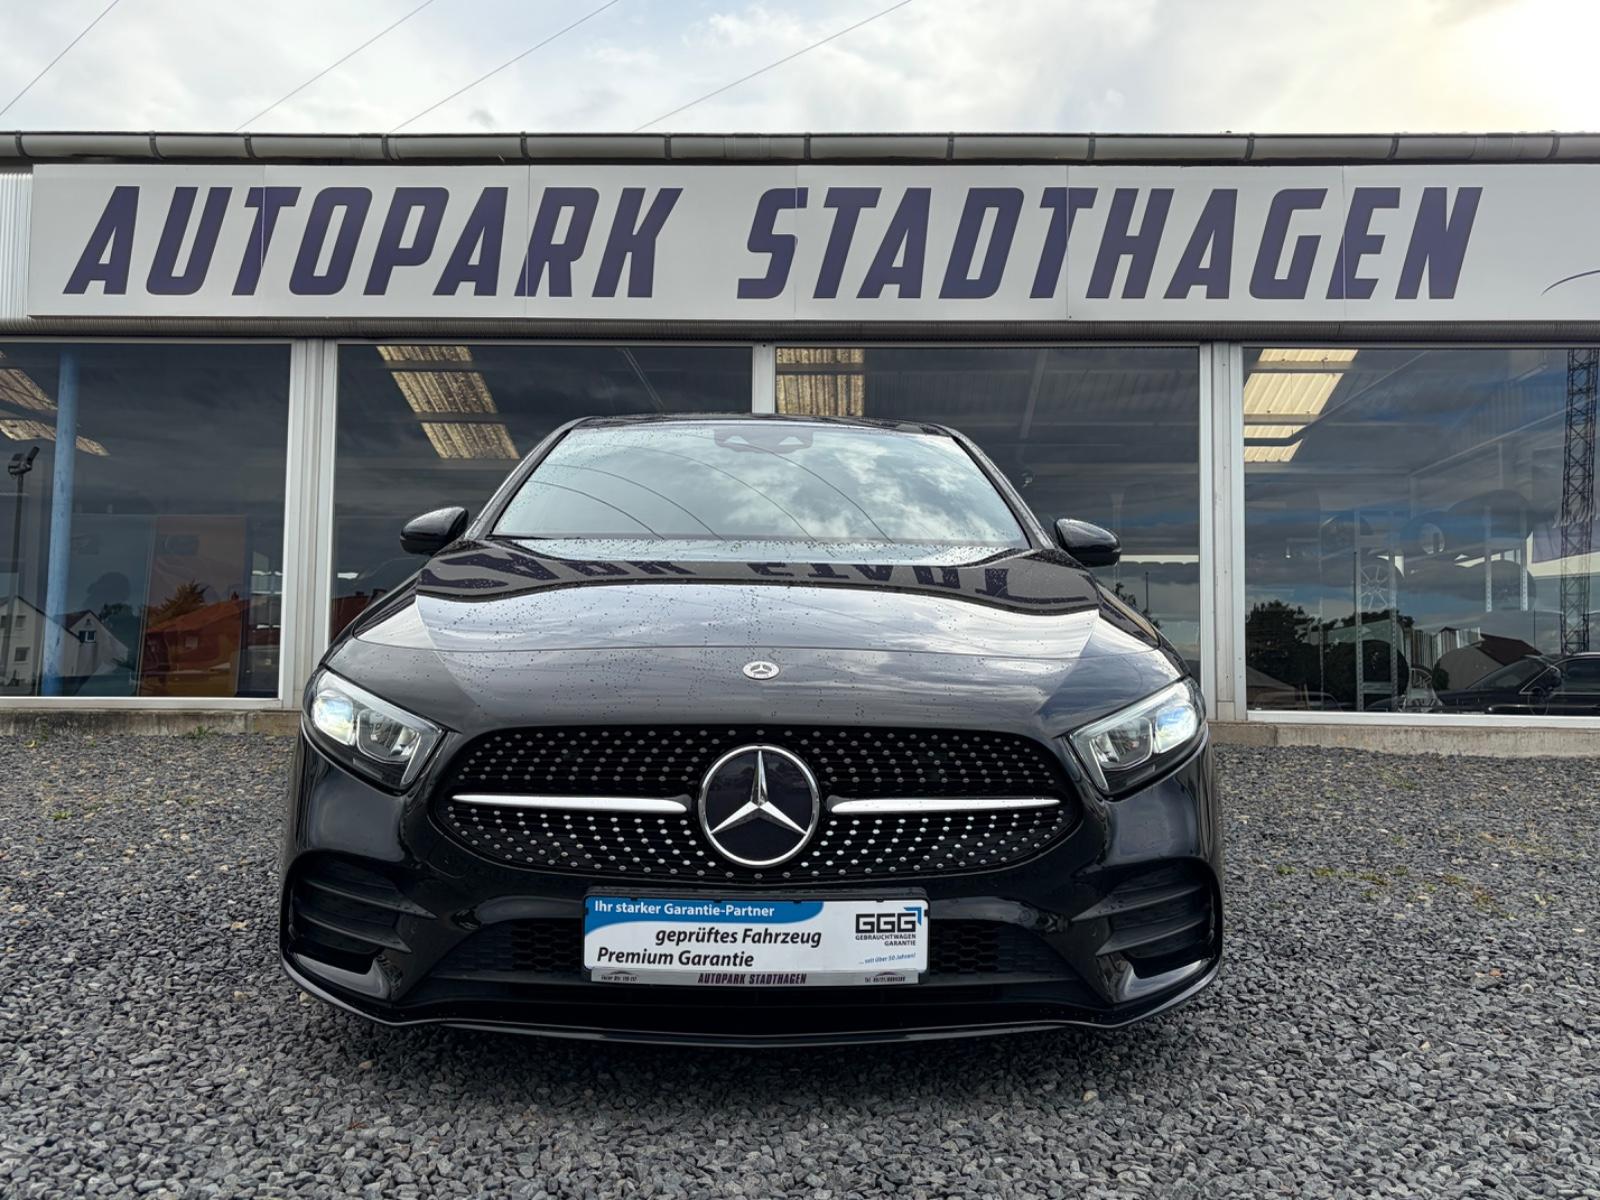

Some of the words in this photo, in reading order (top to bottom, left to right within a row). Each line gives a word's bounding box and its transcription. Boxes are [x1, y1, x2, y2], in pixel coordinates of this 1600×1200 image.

[63, 186, 683, 299] AUTOPARK
[737, 187, 1482, 300] STADTHAGEN
[595, 900, 613, 912] Ihr
[616, 902, 661, 914] starker
[664, 903, 775, 917] Garantie-Partner
[856, 913, 916, 933] GGG
[656, 926, 739, 946] geprüftes
[742, 928, 822, 948] Fahrzeug
[597, 947, 673, 965] Premium
[678, 950, 754, 967] Garantie
[697, 973, 746, 985] AUTOPARK
[749, 973, 807, 985] STADTHAGEN
